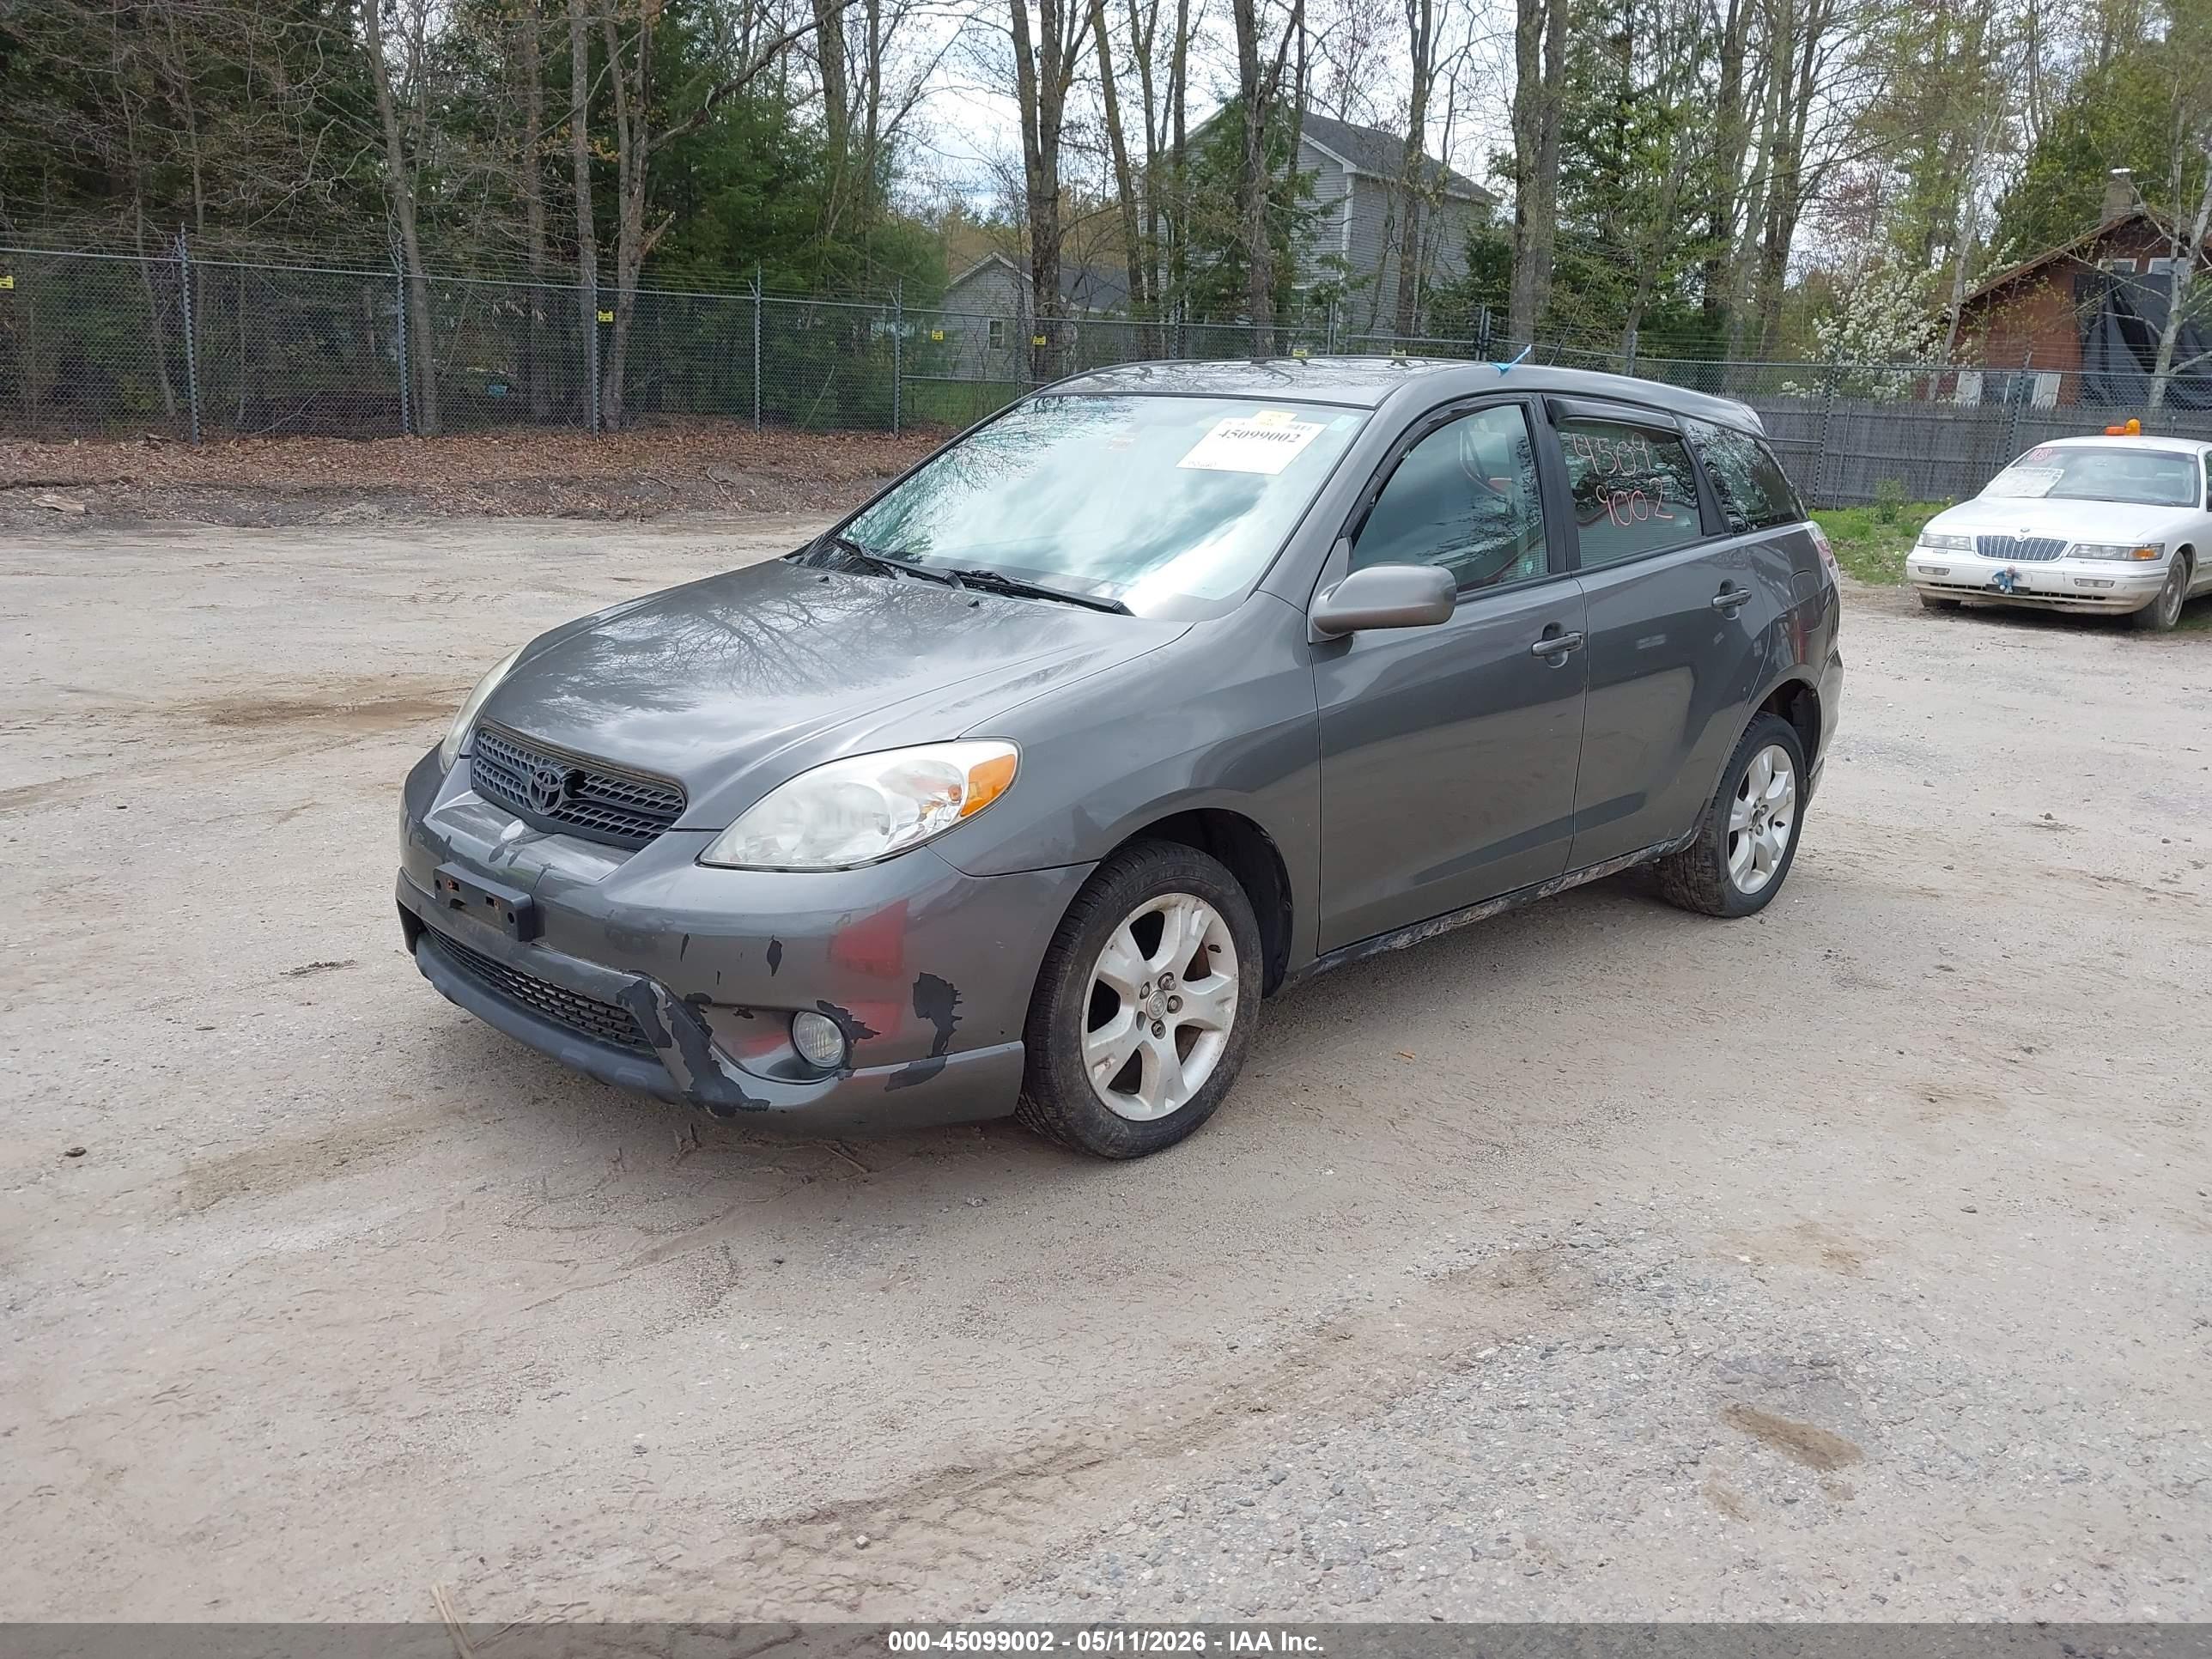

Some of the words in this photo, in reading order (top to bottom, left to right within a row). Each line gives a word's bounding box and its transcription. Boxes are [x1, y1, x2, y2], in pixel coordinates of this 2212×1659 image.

[1218, 428, 1302, 444] 45099002
[1571, 432, 1653, 477] 4509
[1595, 477, 1674, 526] 9002
